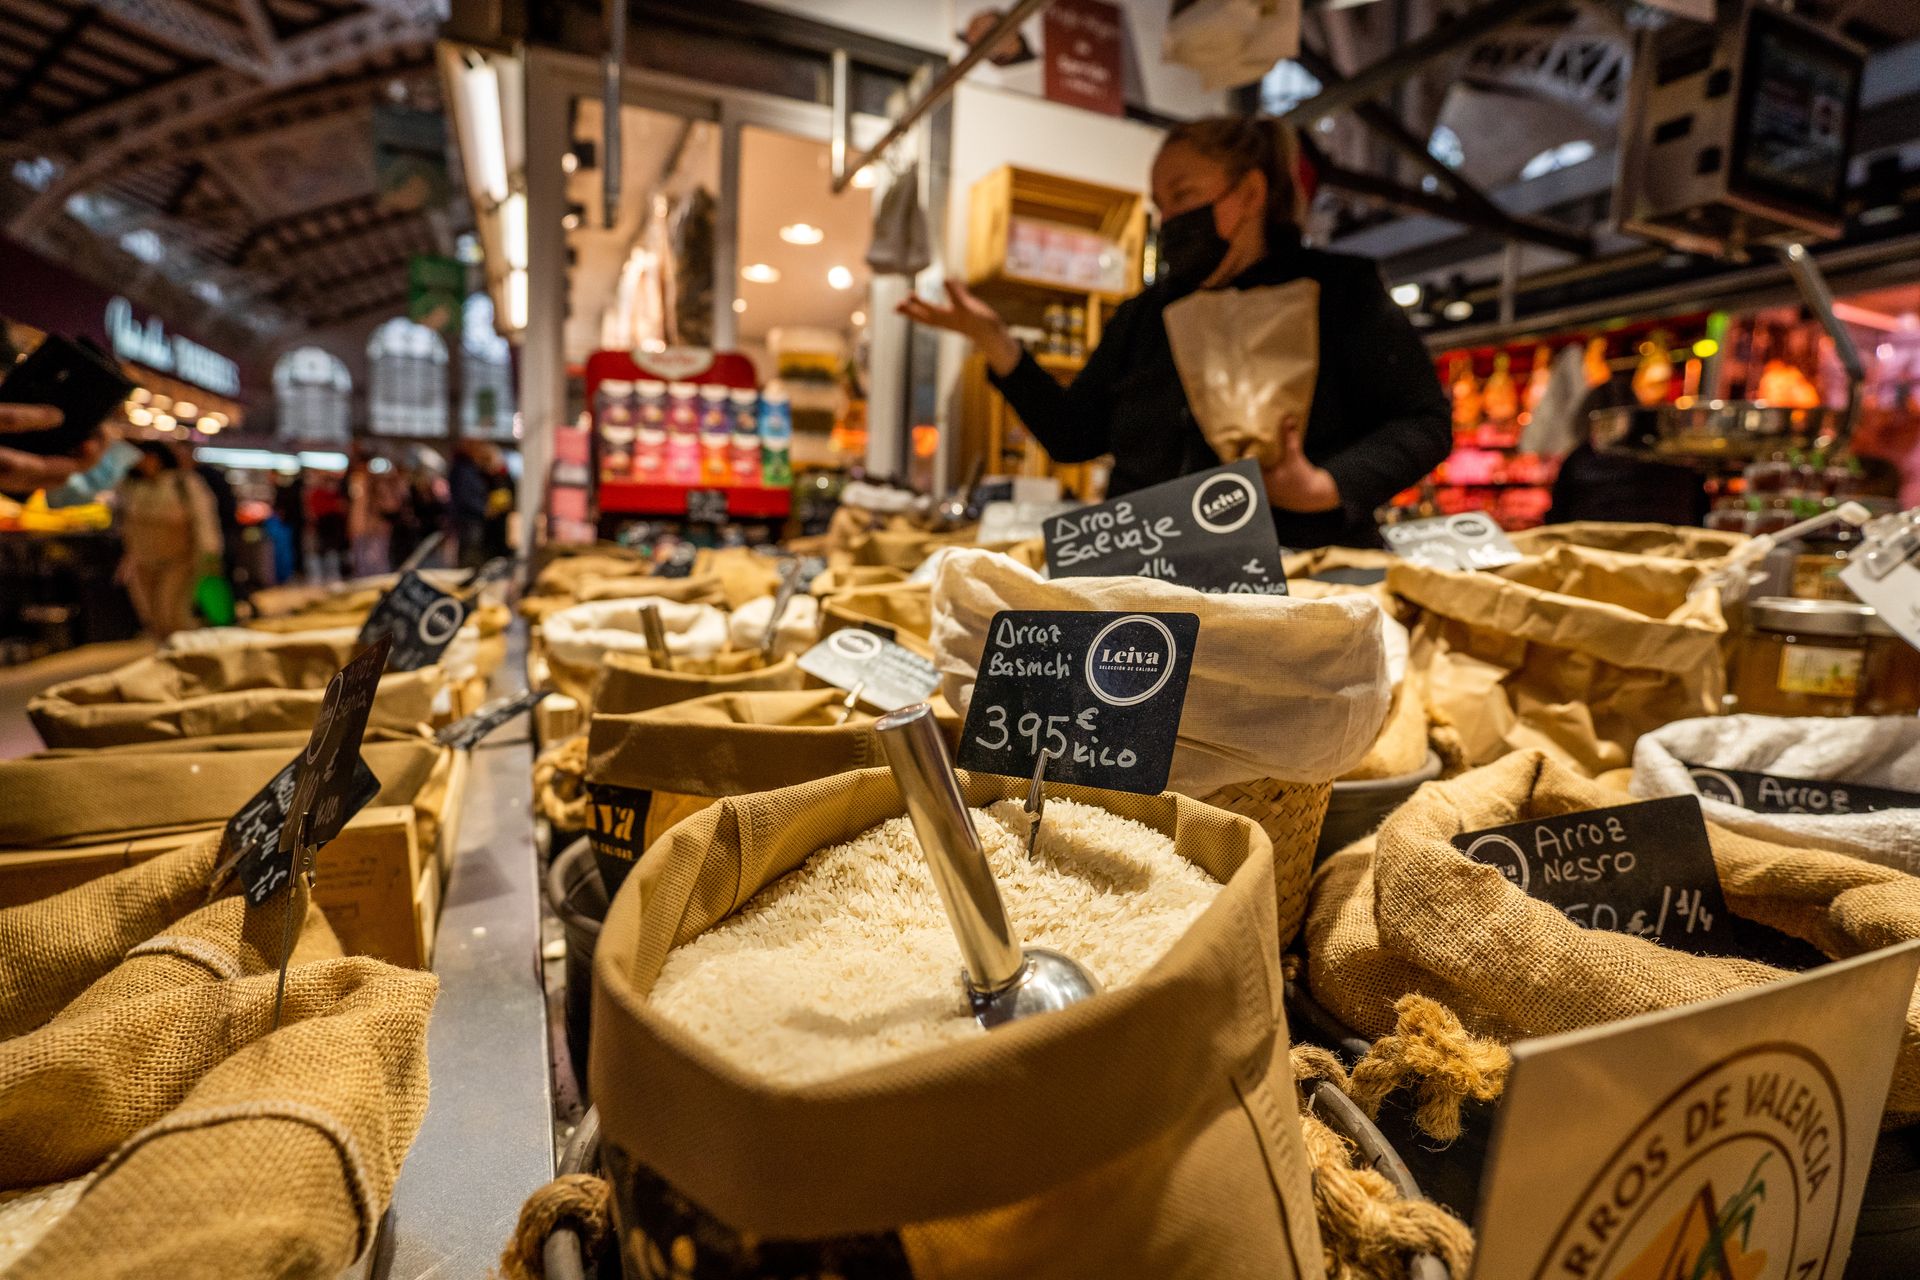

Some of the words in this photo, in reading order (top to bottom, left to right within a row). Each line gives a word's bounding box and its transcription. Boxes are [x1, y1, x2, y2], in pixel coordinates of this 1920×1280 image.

[1052, 501, 1136, 543] Arroz
[995, 617, 1062, 649] Arroz
[1101, 646, 1160, 665] Leiva
[1757, 776, 1850, 809] Arroz
[1534, 816, 1628, 858] Arroz
[1684, 1083, 1734, 1149] DE
[1743, 1071, 1834, 1203] VALENCIA
